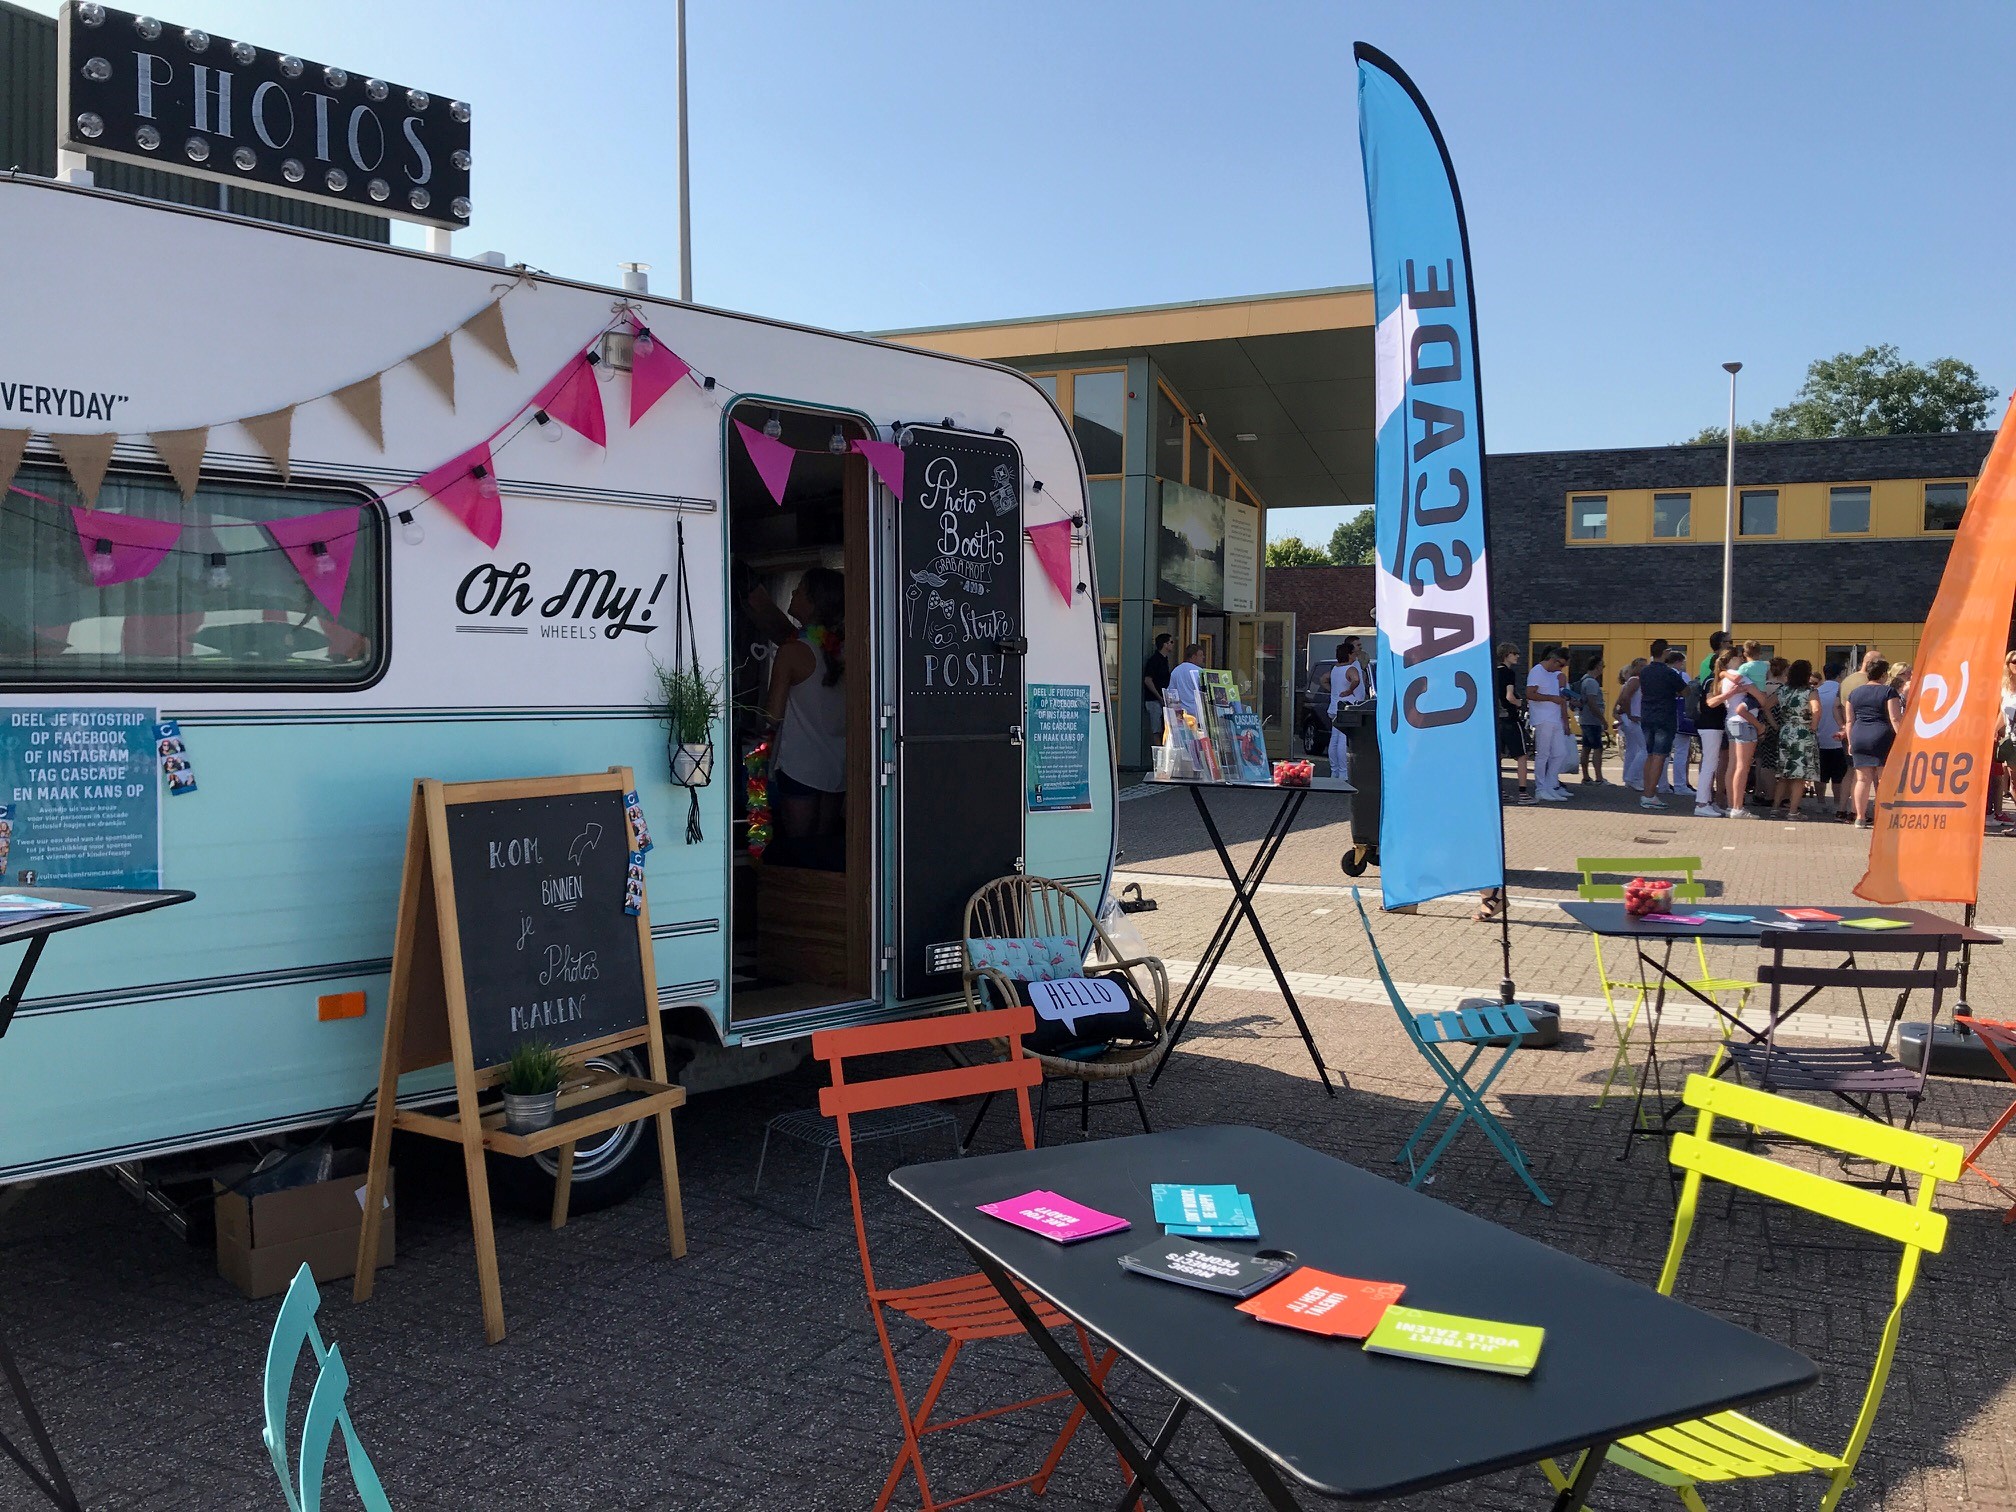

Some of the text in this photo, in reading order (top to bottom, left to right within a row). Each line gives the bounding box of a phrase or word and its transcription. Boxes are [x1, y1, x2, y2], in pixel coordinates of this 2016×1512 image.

[132, 50, 432, 185] PHOTOS
[920, 456, 987, 515] Photo
[937, 511, 1004, 565] Booth
[935, 557, 985, 580] GRAB A PROP
[963, 581, 985, 596] AND
[455, 562, 668, 640] Oh My!
[960, 601, 1012, 642] Strike
[541, 625, 597, 640] WHEELS
[924, 653, 1005, 687] POSE!
[1033, 688, 1086, 697] DEEL JE FOTOSTRIP
[1040, 700, 1078, 708] OP FACEBOOK
[12, 712, 145, 727] DEEL JE FOTOSTRIP
[1038, 711, 1079, 719] OF INSTAGRAM
[1234, 714, 1261, 726] CASCADE
[1040, 722, 1077, 731] TAG CASCADE
[31, 731, 126, 745] OP FACEBOOK
[1033, 733, 1084, 742] EN MAAK KANS OP
[25, 749, 129, 764] OF INSTAGRAM
[29, 767, 126, 783] TAG CASCADE
[13, 784, 145, 801] EN MAAK KANS OP
[489, 837, 543, 869] KOM
[517, 911, 535, 950] je
[539, 944, 599, 986] Photos
[1044, 981, 1112, 1010] HELLO
[510, 994, 586, 1032] MAKEN
[1198, 1193, 1216, 1212] HAPPY
[1019, 1209, 1070, 1228] ARE YOU
[1033, 1206, 1081, 1224] READY?
[1165, 1253, 1240, 1277] CONNECTS
[1185, 1250, 1241, 1269] PEOPLE
[1167, 1262, 1216, 1279] MUSIC
[1286, 1286, 1330, 1313] JIJ HEBT
[1408, 1333, 1499, 1353] JIJ TREKT
[1465, 1332, 1520, 1349] VOLLE
